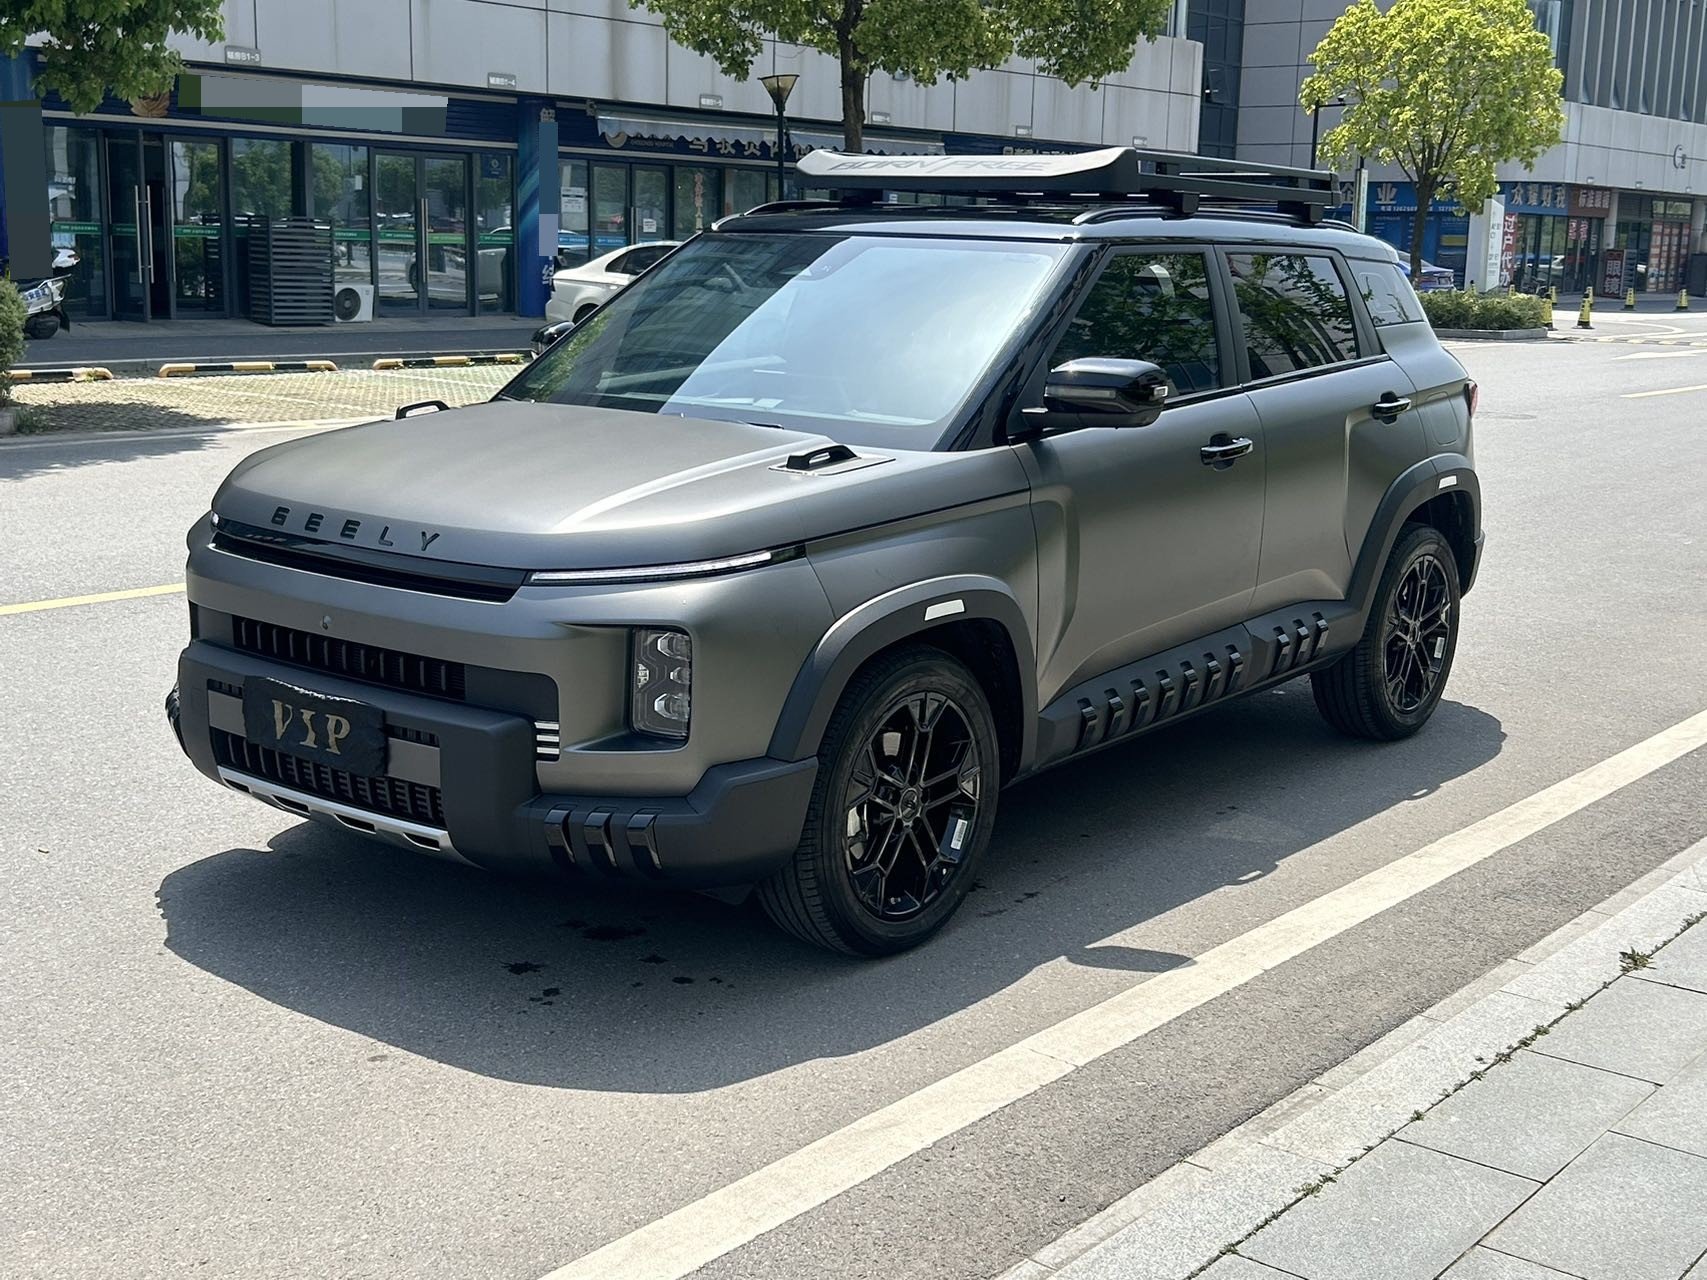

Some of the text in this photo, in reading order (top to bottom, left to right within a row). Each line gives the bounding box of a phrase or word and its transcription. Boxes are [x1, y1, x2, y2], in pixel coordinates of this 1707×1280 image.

[1500, 214, 1516, 287] 过户代办
[1604, 260, 1622, 294] 眼镜
[271, 506, 440, 551] GEELY
[271, 699, 351, 755] VIP
